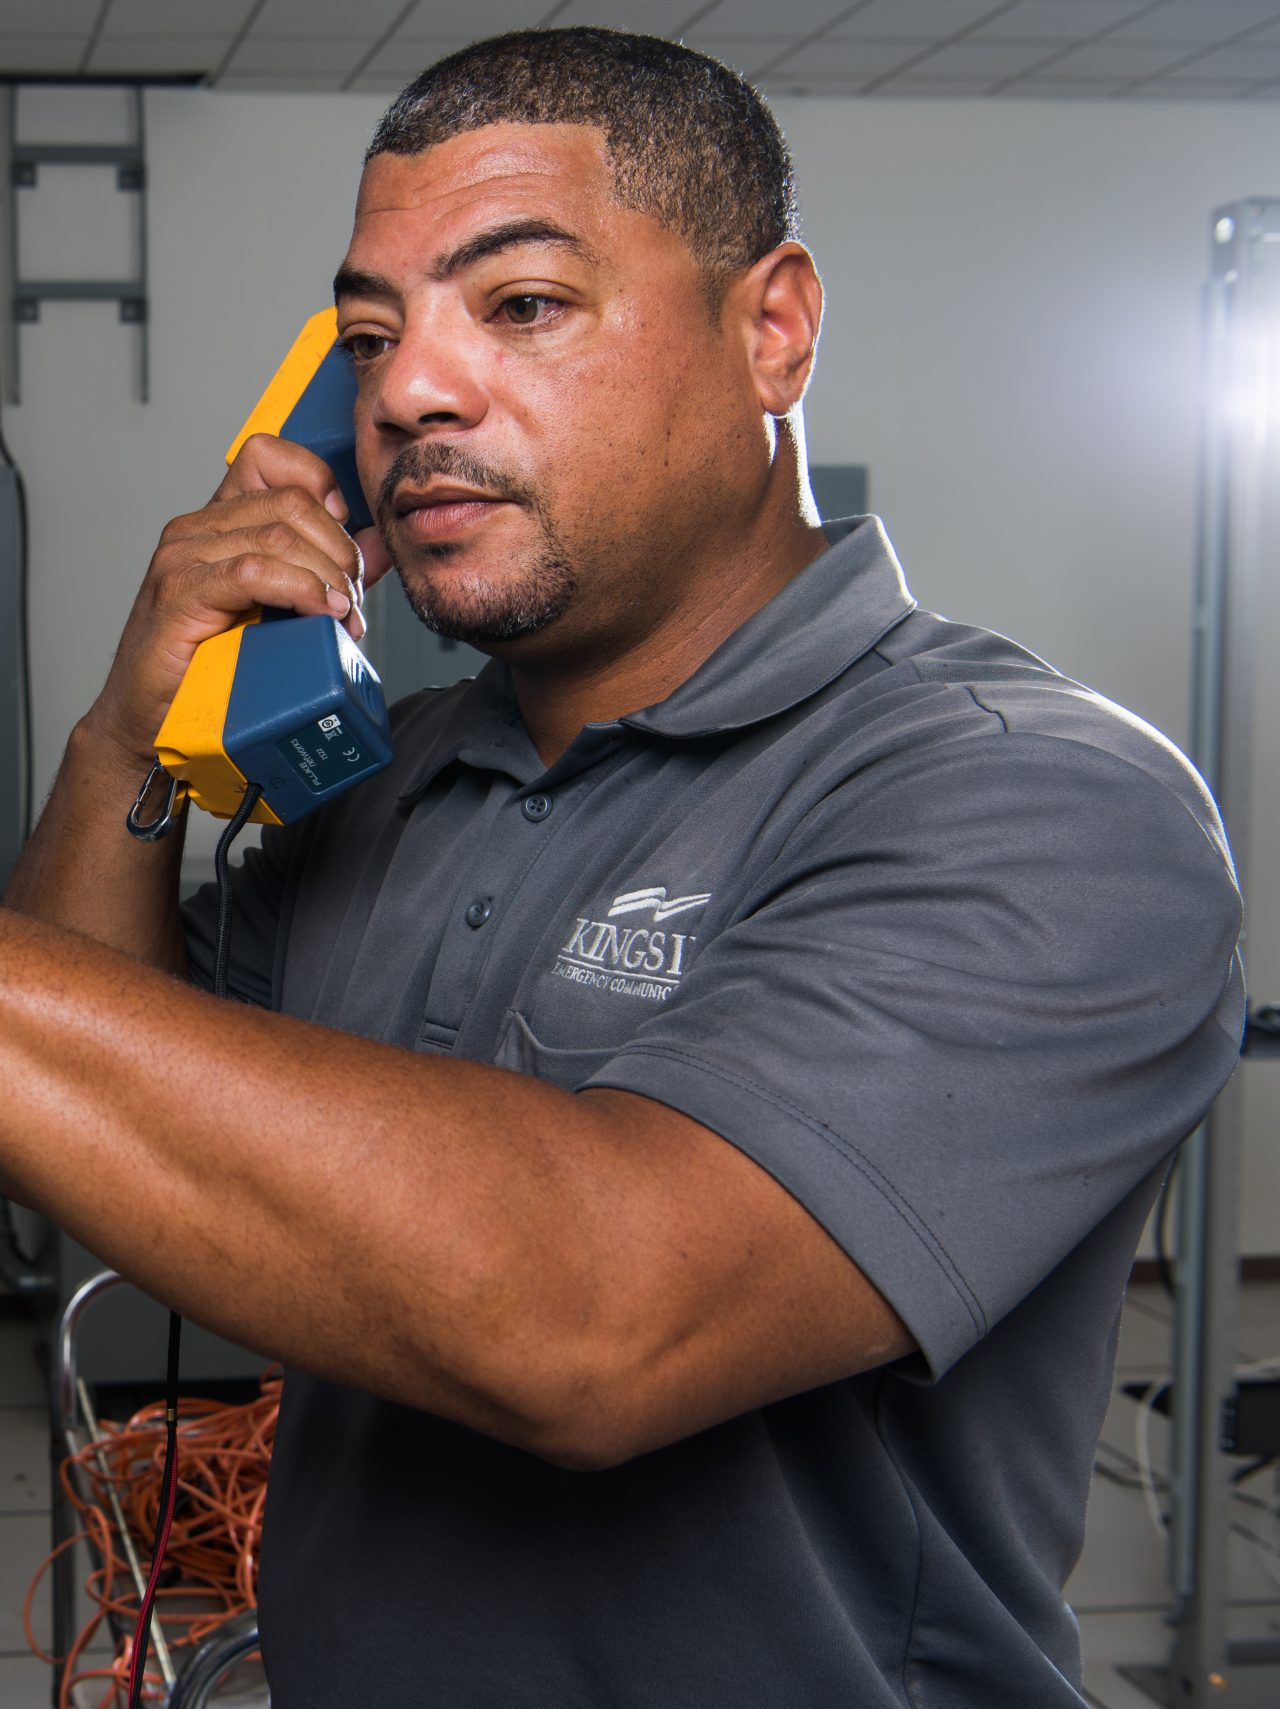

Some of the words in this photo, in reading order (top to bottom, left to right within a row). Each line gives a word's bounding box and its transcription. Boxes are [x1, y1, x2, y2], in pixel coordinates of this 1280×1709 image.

[290, 739, 317, 768] networks
[299, 762, 322, 786] FLUKE
[551, 961, 612, 990] EMERGENCY
[610, 977, 680, 1000] COMMUNIC
